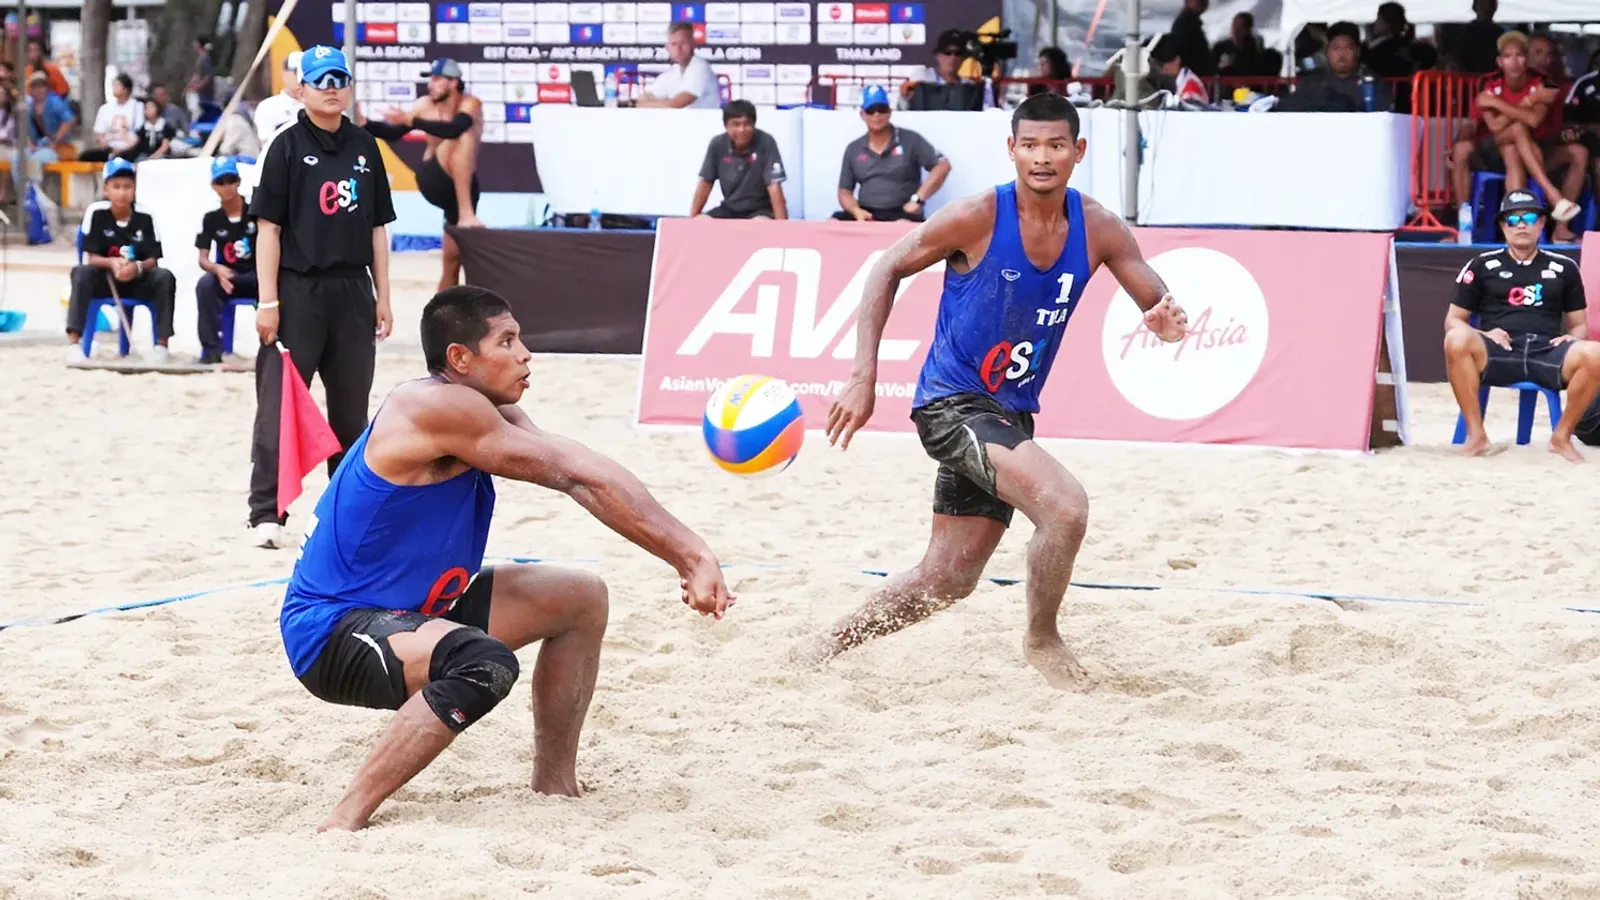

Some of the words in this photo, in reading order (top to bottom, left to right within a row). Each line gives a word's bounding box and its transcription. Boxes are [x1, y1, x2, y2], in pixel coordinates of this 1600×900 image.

[385, 46, 425, 58] BEACH
[506, 46, 541, 59] COLA
[576, 46, 619, 60] BEACH
[725, 47, 762, 60] OPEN
[835, 47, 902, 61] THAILAND
[319, 178, 358, 215] est
[1055, 272, 1075, 304] 1
[1508, 283, 1543, 306] est
[675, 247, 947, 361] AVC
[980, 338, 1048, 393] est
